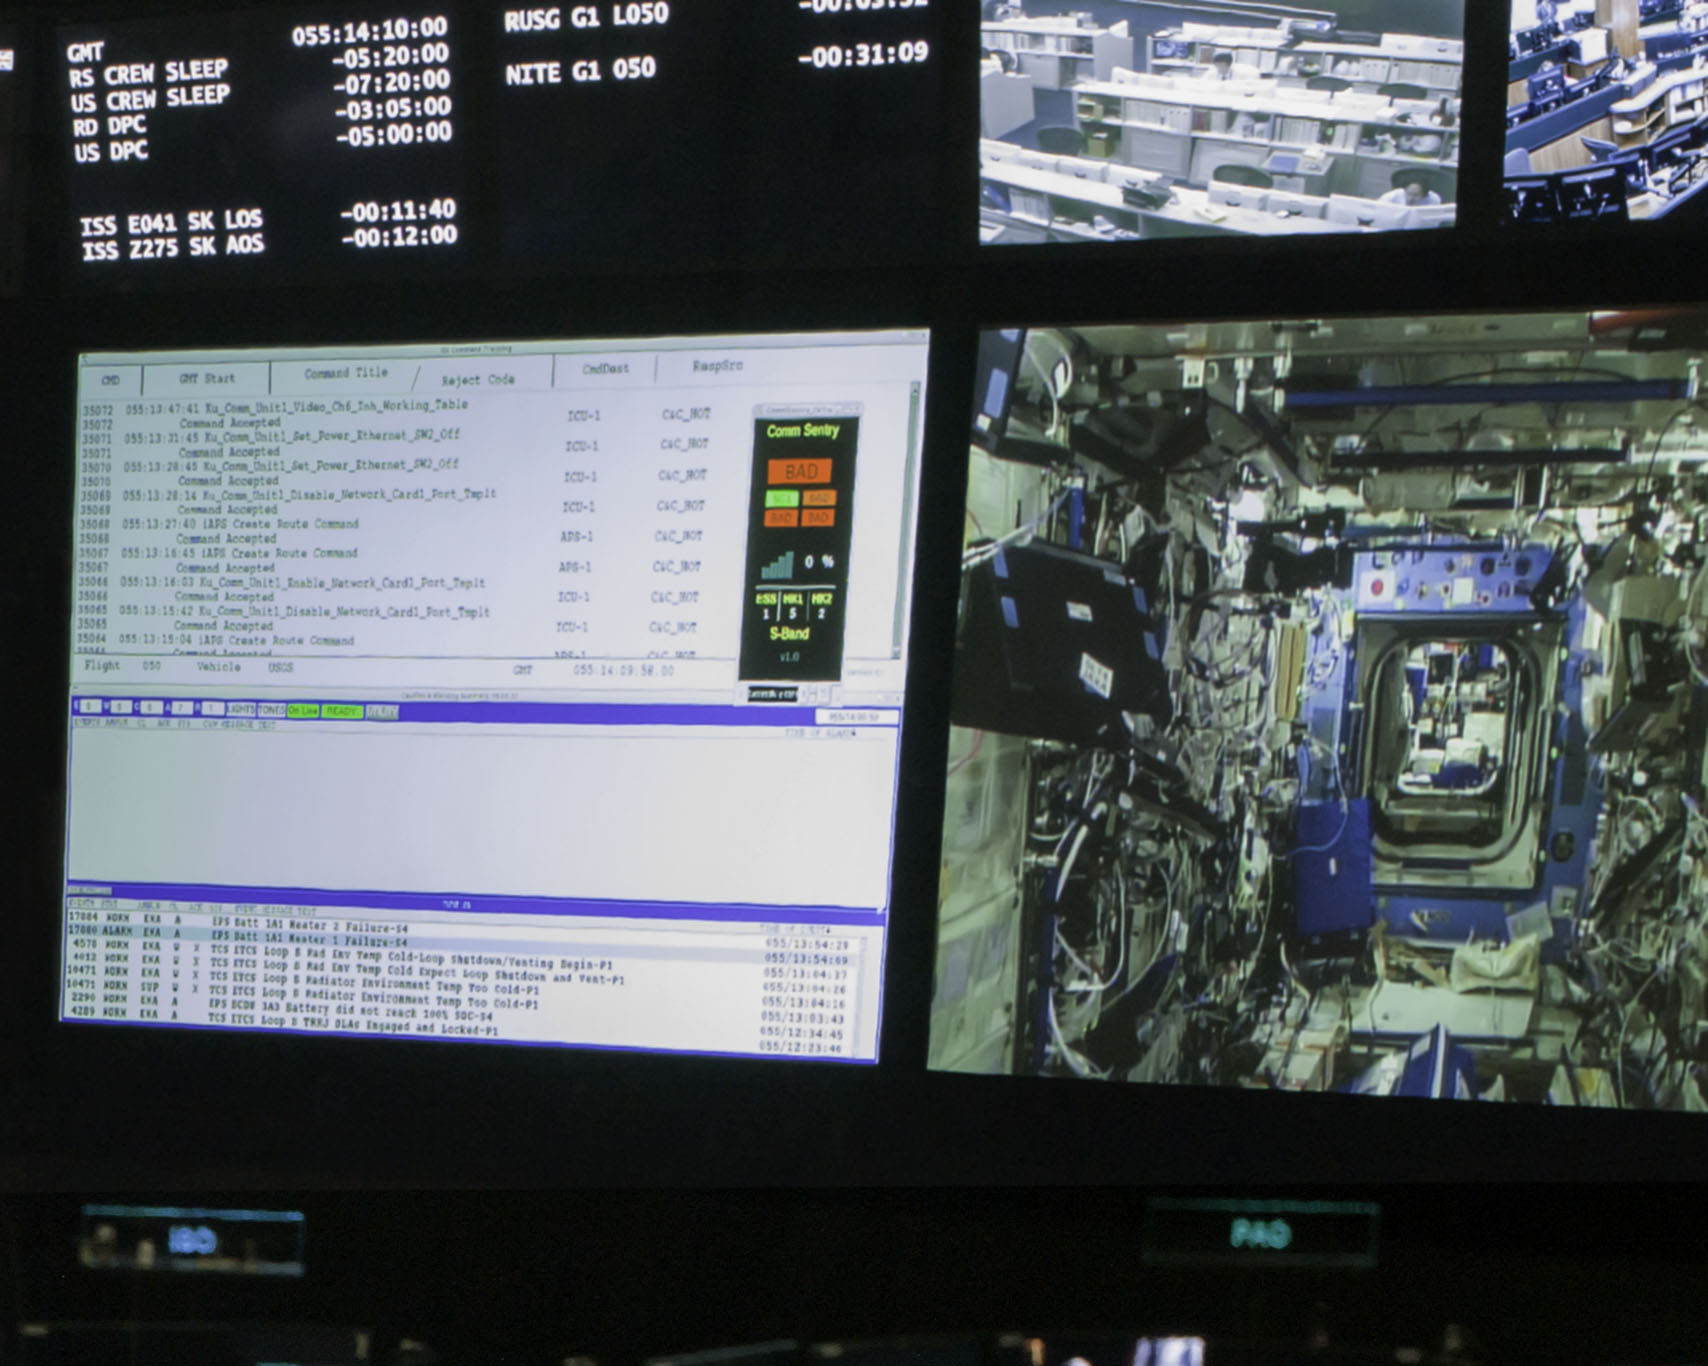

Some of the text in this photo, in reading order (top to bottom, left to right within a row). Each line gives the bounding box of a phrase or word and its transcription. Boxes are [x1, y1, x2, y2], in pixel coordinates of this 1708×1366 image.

[505, 9, 560, 33] RUSG
[572, 7, 600, 28] G1
[613, 2, 669, 26] L050
[68, 17, 447, 62] GMT 055:14:10:00
[70, 44, 448, 88] RS CREW SLEEP -05:20:00
[507, 41, 929, 85] NITE G1 050 -00:31:09
[72, 70, 450, 112] US CREW SLEEP -07:20:00
[74, 96, 452, 137] RD DPC -03:05:00
[75, 122, 452, 162] US DPC -05:00:00
[82, 200, 456, 237] ISS E041 SK LOS -00:11:40
[83, 225, 457, 261] ISS Z275 SK AOS -00:12:00
[205, 374, 235, 384] Start
[305, 367, 388, 379] Command Title
[442, 375, 514, 388] Reject Code
[180, 417, 280, 429] Command Accepted
[767, 423, 840, 440] Comm Sentry
[786, 463, 818, 480] BAD
[770, 626, 810, 640] S-Band
[85, 660, 241, 672] Flight Vehicle
